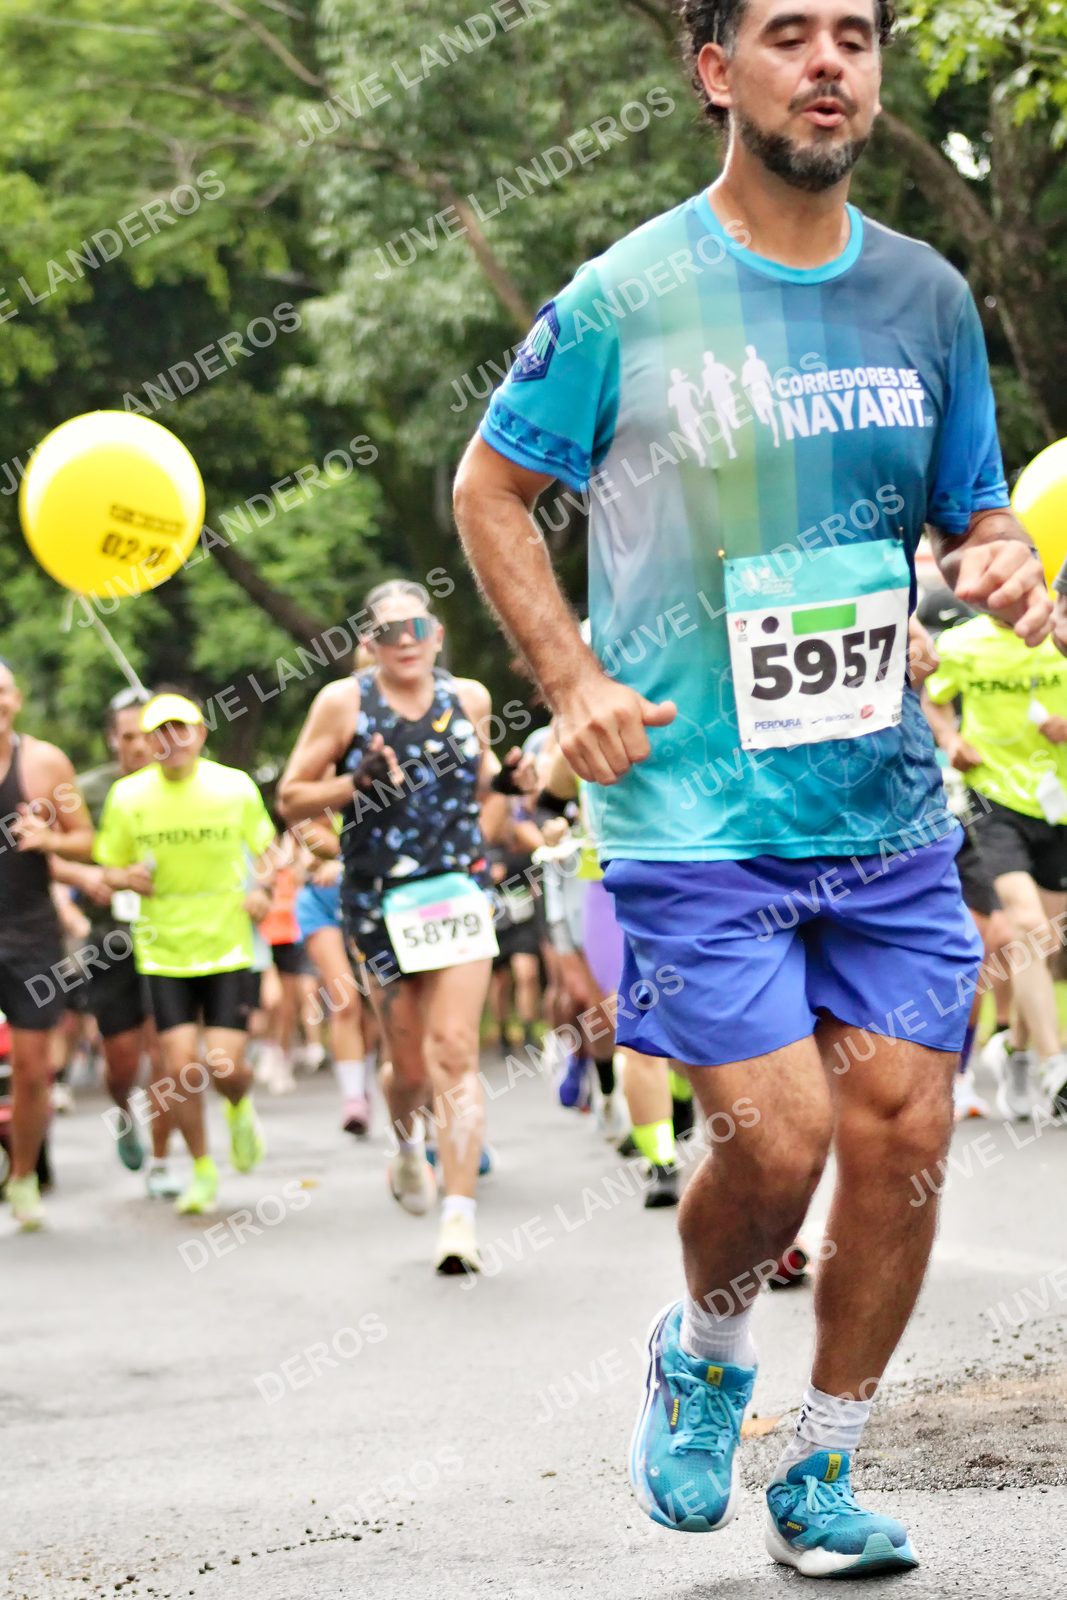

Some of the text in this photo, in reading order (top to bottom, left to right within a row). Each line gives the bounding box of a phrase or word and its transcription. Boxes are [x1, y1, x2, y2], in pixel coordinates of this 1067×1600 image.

[775, 367, 921, 399] CORREDORES DE
[779, 388, 924, 440] NAYARIT
[751, 624, 897, 700] 5957
[754, 717, 802, 731] PERDURA
[403, 913, 483, 948] 5879
